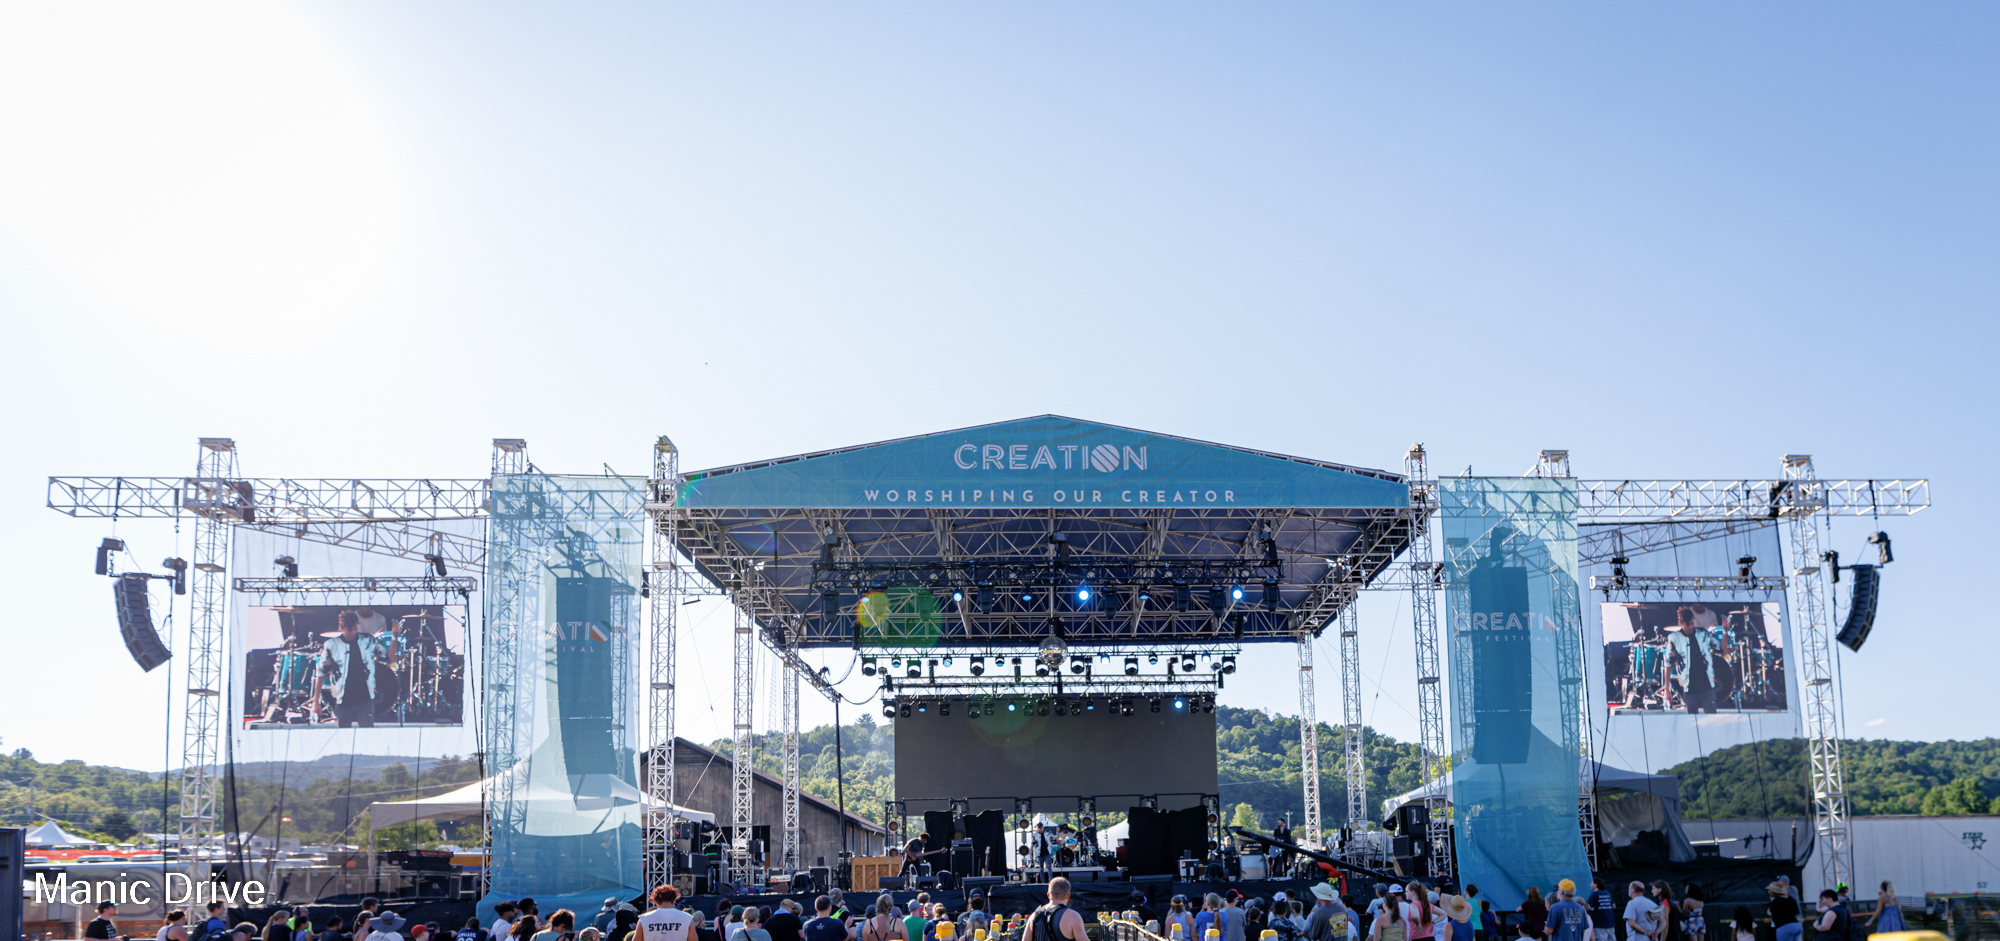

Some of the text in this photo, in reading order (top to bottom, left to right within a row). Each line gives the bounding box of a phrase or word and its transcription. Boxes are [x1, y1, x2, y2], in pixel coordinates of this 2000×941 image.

[953, 443, 1148, 473] CREATION
[864, 489, 1236, 503] WORSHIPING OUR CREATOR
[1454, 612, 1578, 632] CREATION
[648, 923, 681, 932] STAFF
